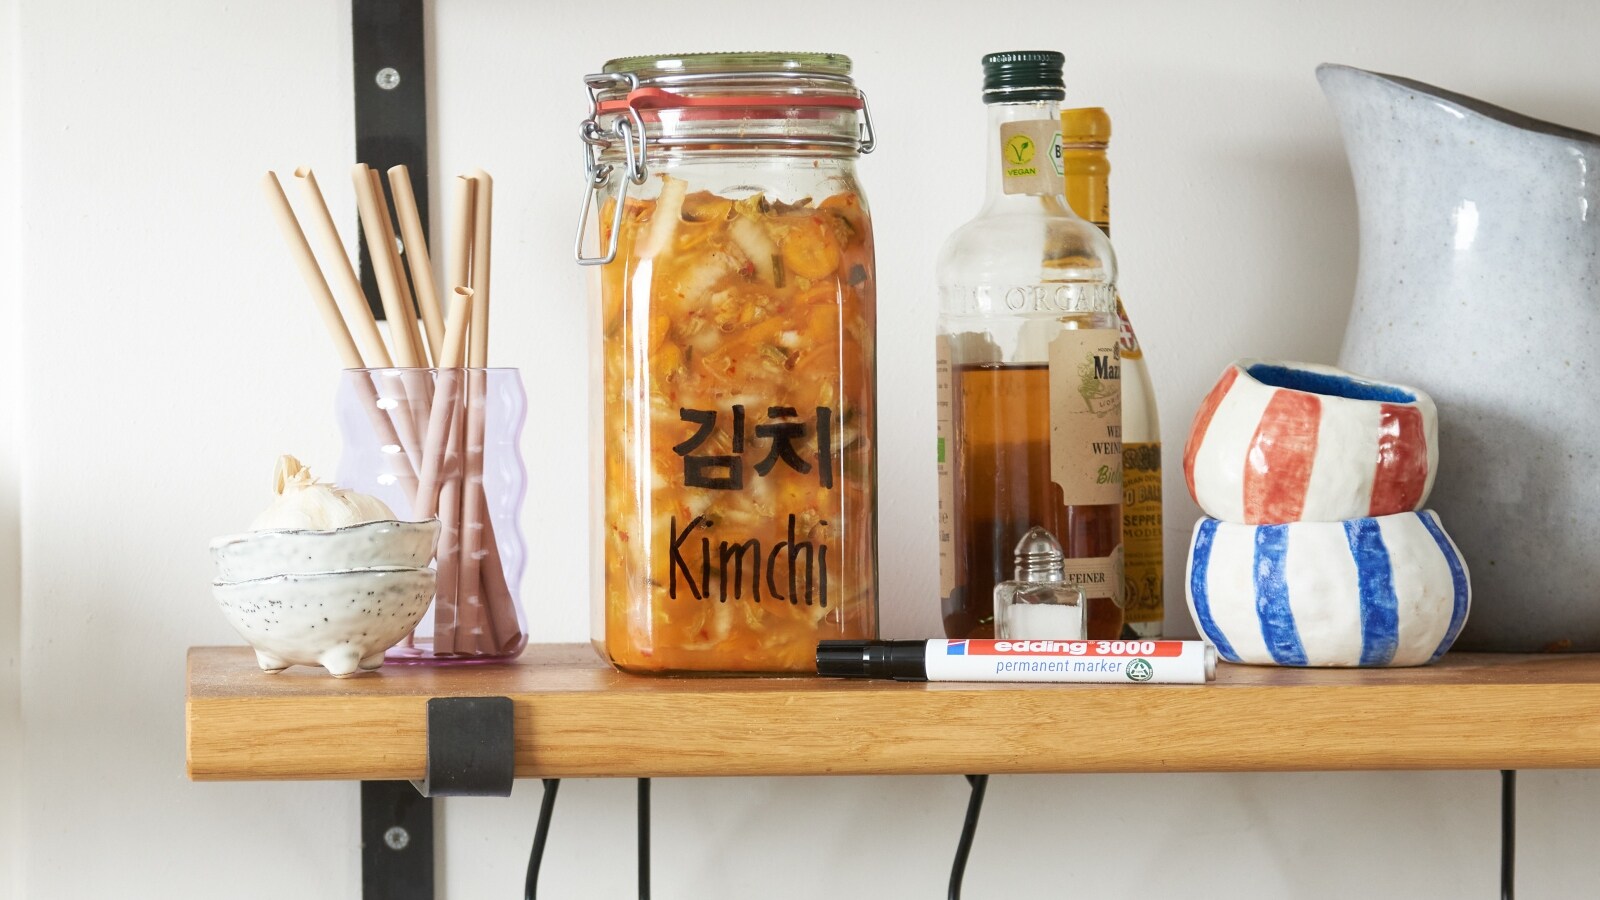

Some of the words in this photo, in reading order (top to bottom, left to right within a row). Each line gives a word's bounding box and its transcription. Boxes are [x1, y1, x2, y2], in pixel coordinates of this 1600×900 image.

[1007, 168, 1036, 176] VEGAN
[672, 404, 833, 490] 김치
[669, 513, 828, 607] Kimchi
[1069, 572, 1105, 584] FEINER
[994, 640, 1087, 656] edding
[1095, 641, 1155, 655] 3000
[996, 659, 1069, 674] permanent
[1073, 658, 1122, 673] marker
